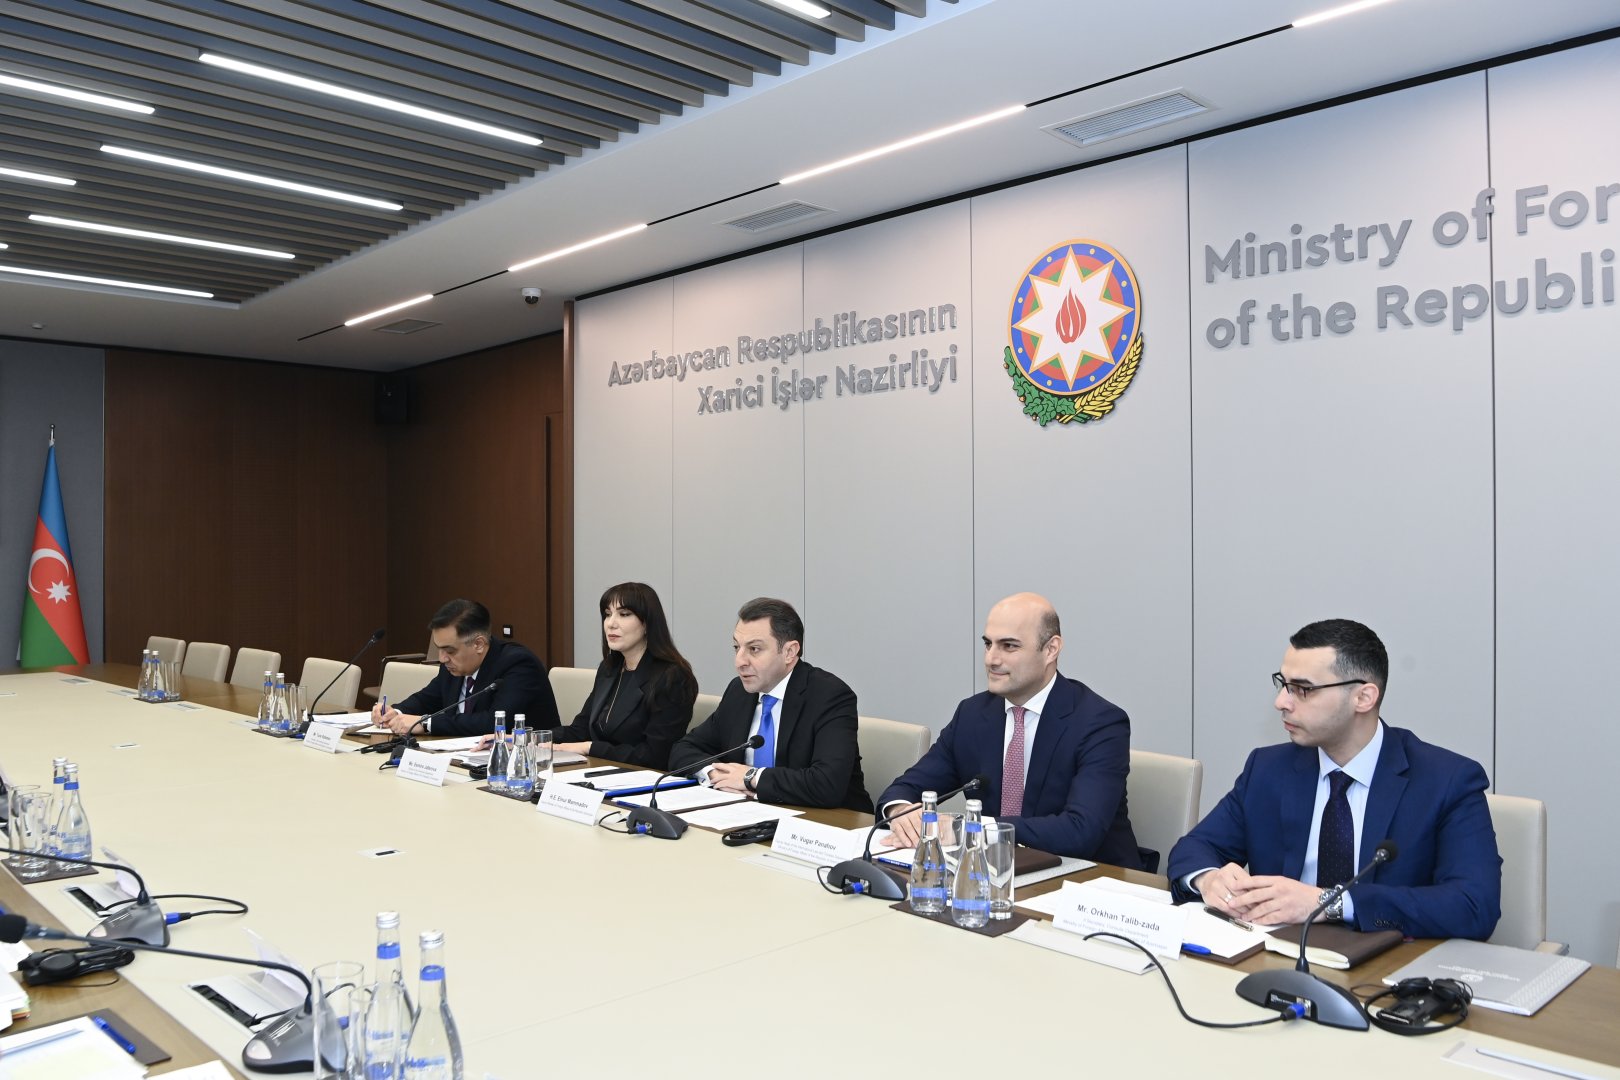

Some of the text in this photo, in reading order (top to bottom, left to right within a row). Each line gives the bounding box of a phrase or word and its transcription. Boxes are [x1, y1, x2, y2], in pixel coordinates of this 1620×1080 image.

[1204, 182, 1620, 284] Ministry of For
[1206, 248, 1616, 349] of the Republi
[608, 303, 958, 387] Azərbaycan Respublikasının
[697, 344, 958, 416] Xarici İşlər Nazirliyi
[1077, 903, 1089, 914] Mr.
[1090, 907, 1119, 921] Orkhan
[1120, 915, 1160, 931] Talib-zada
